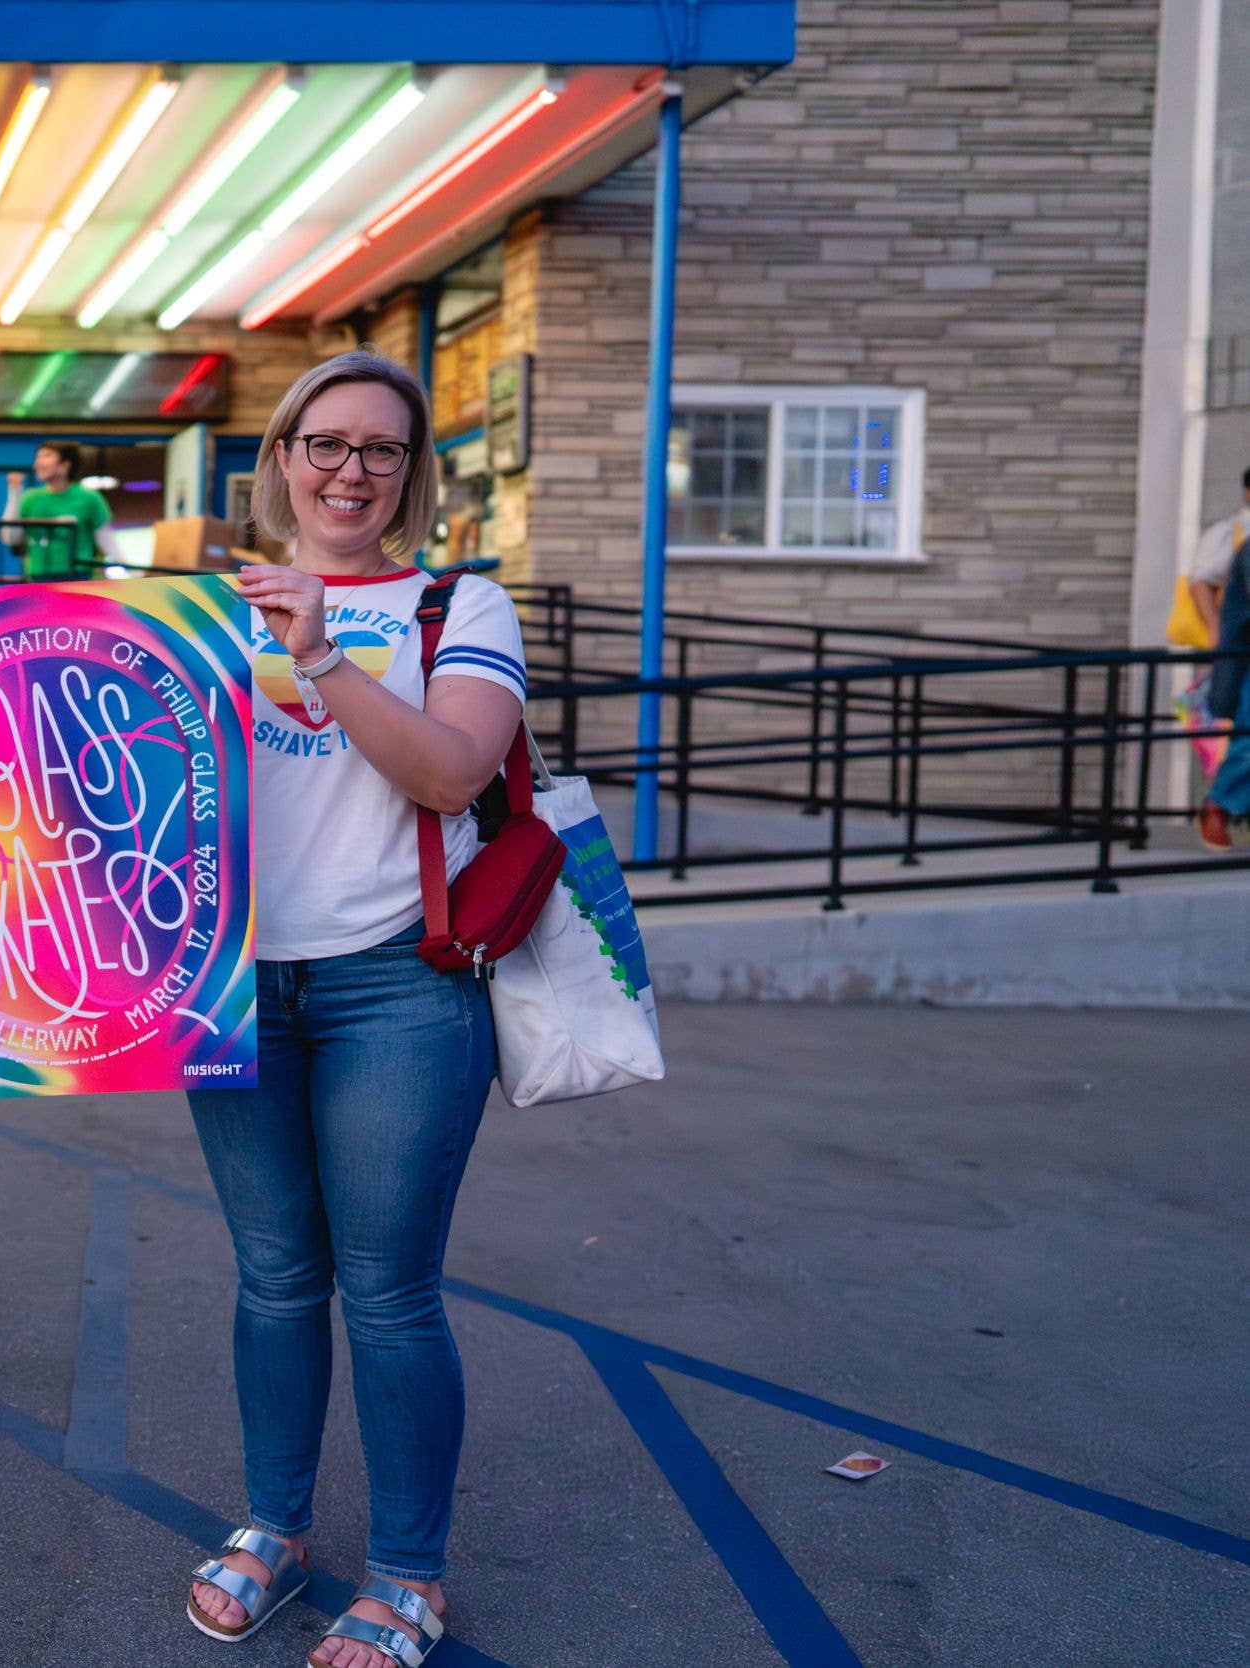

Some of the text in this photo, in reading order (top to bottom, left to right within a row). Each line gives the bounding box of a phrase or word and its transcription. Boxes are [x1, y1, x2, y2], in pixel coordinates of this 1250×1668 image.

[111, 641, 149, 673] OF
[152, 671, 207, 743] PHILIP
[190, 750, 217, 823] GLASS
[125, 843, 218, 1032] MARCH 17, 2024
[184, 1063, 243, 1077] INSIGHT
